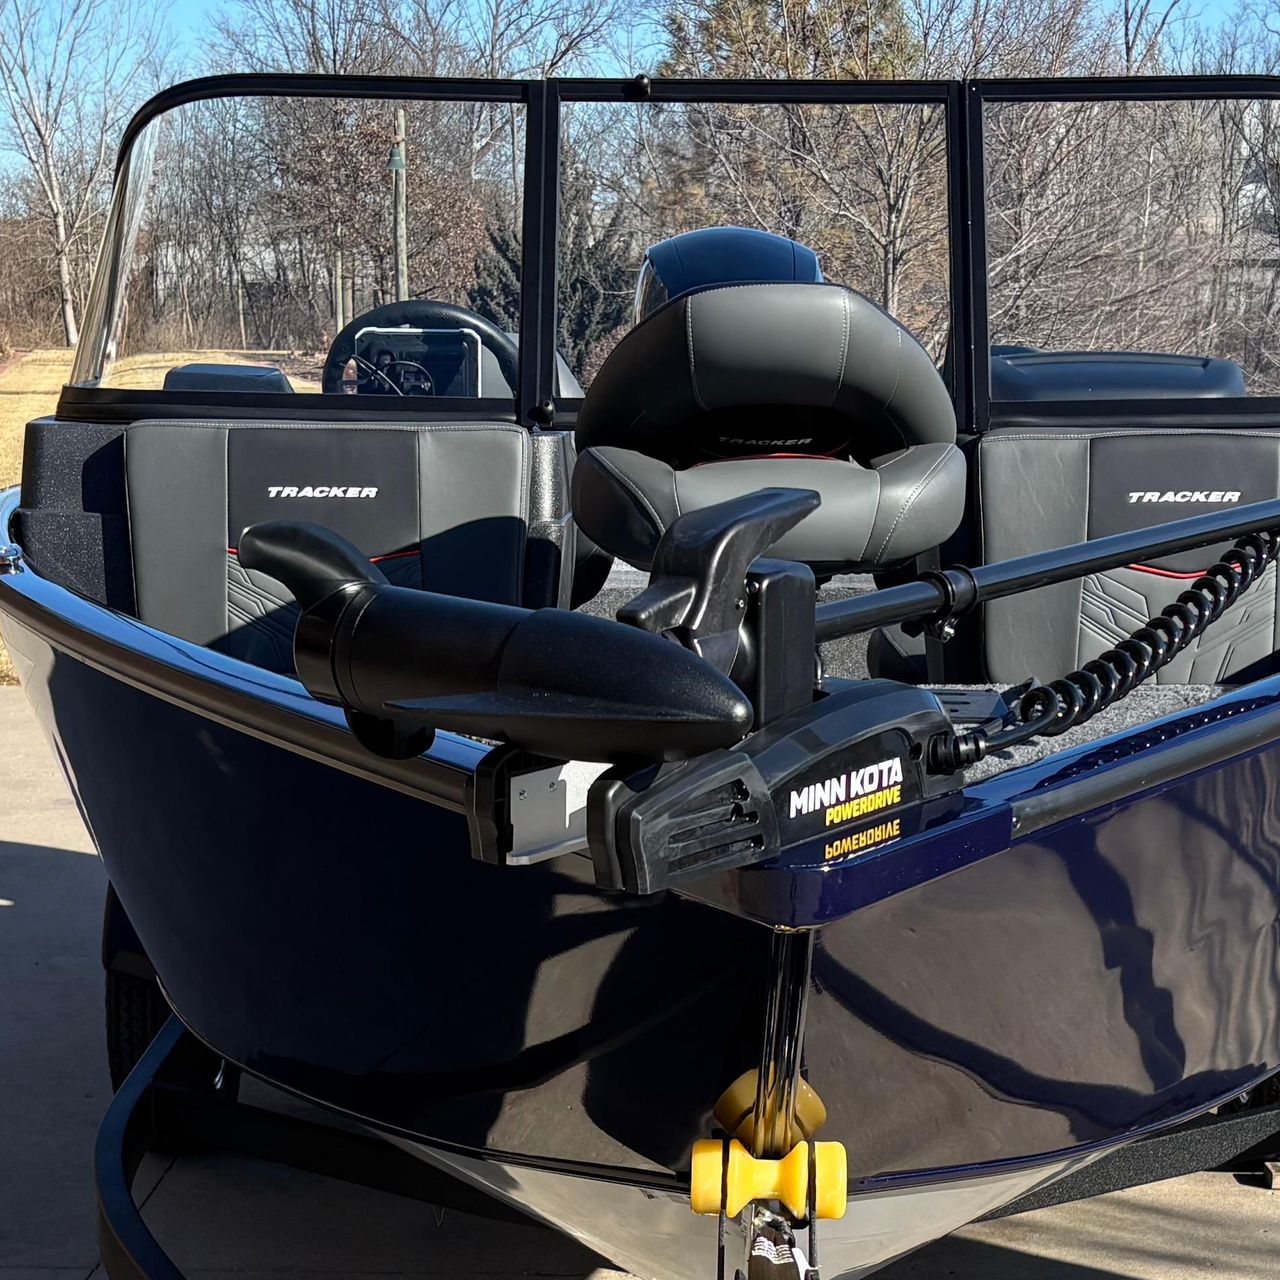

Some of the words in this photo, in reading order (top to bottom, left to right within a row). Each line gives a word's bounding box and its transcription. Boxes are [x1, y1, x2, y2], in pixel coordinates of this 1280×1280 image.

[719, 435, 813, 447] TRACKER
[267, 486, 379, 499] TRACKER
[1128, 491, 1242, 504] TRACKER
[789, 774, 847, 819] MINN
[850, 757, 904, 799] KOTA
[825, 785, 902, 827] POWERDRIVE
